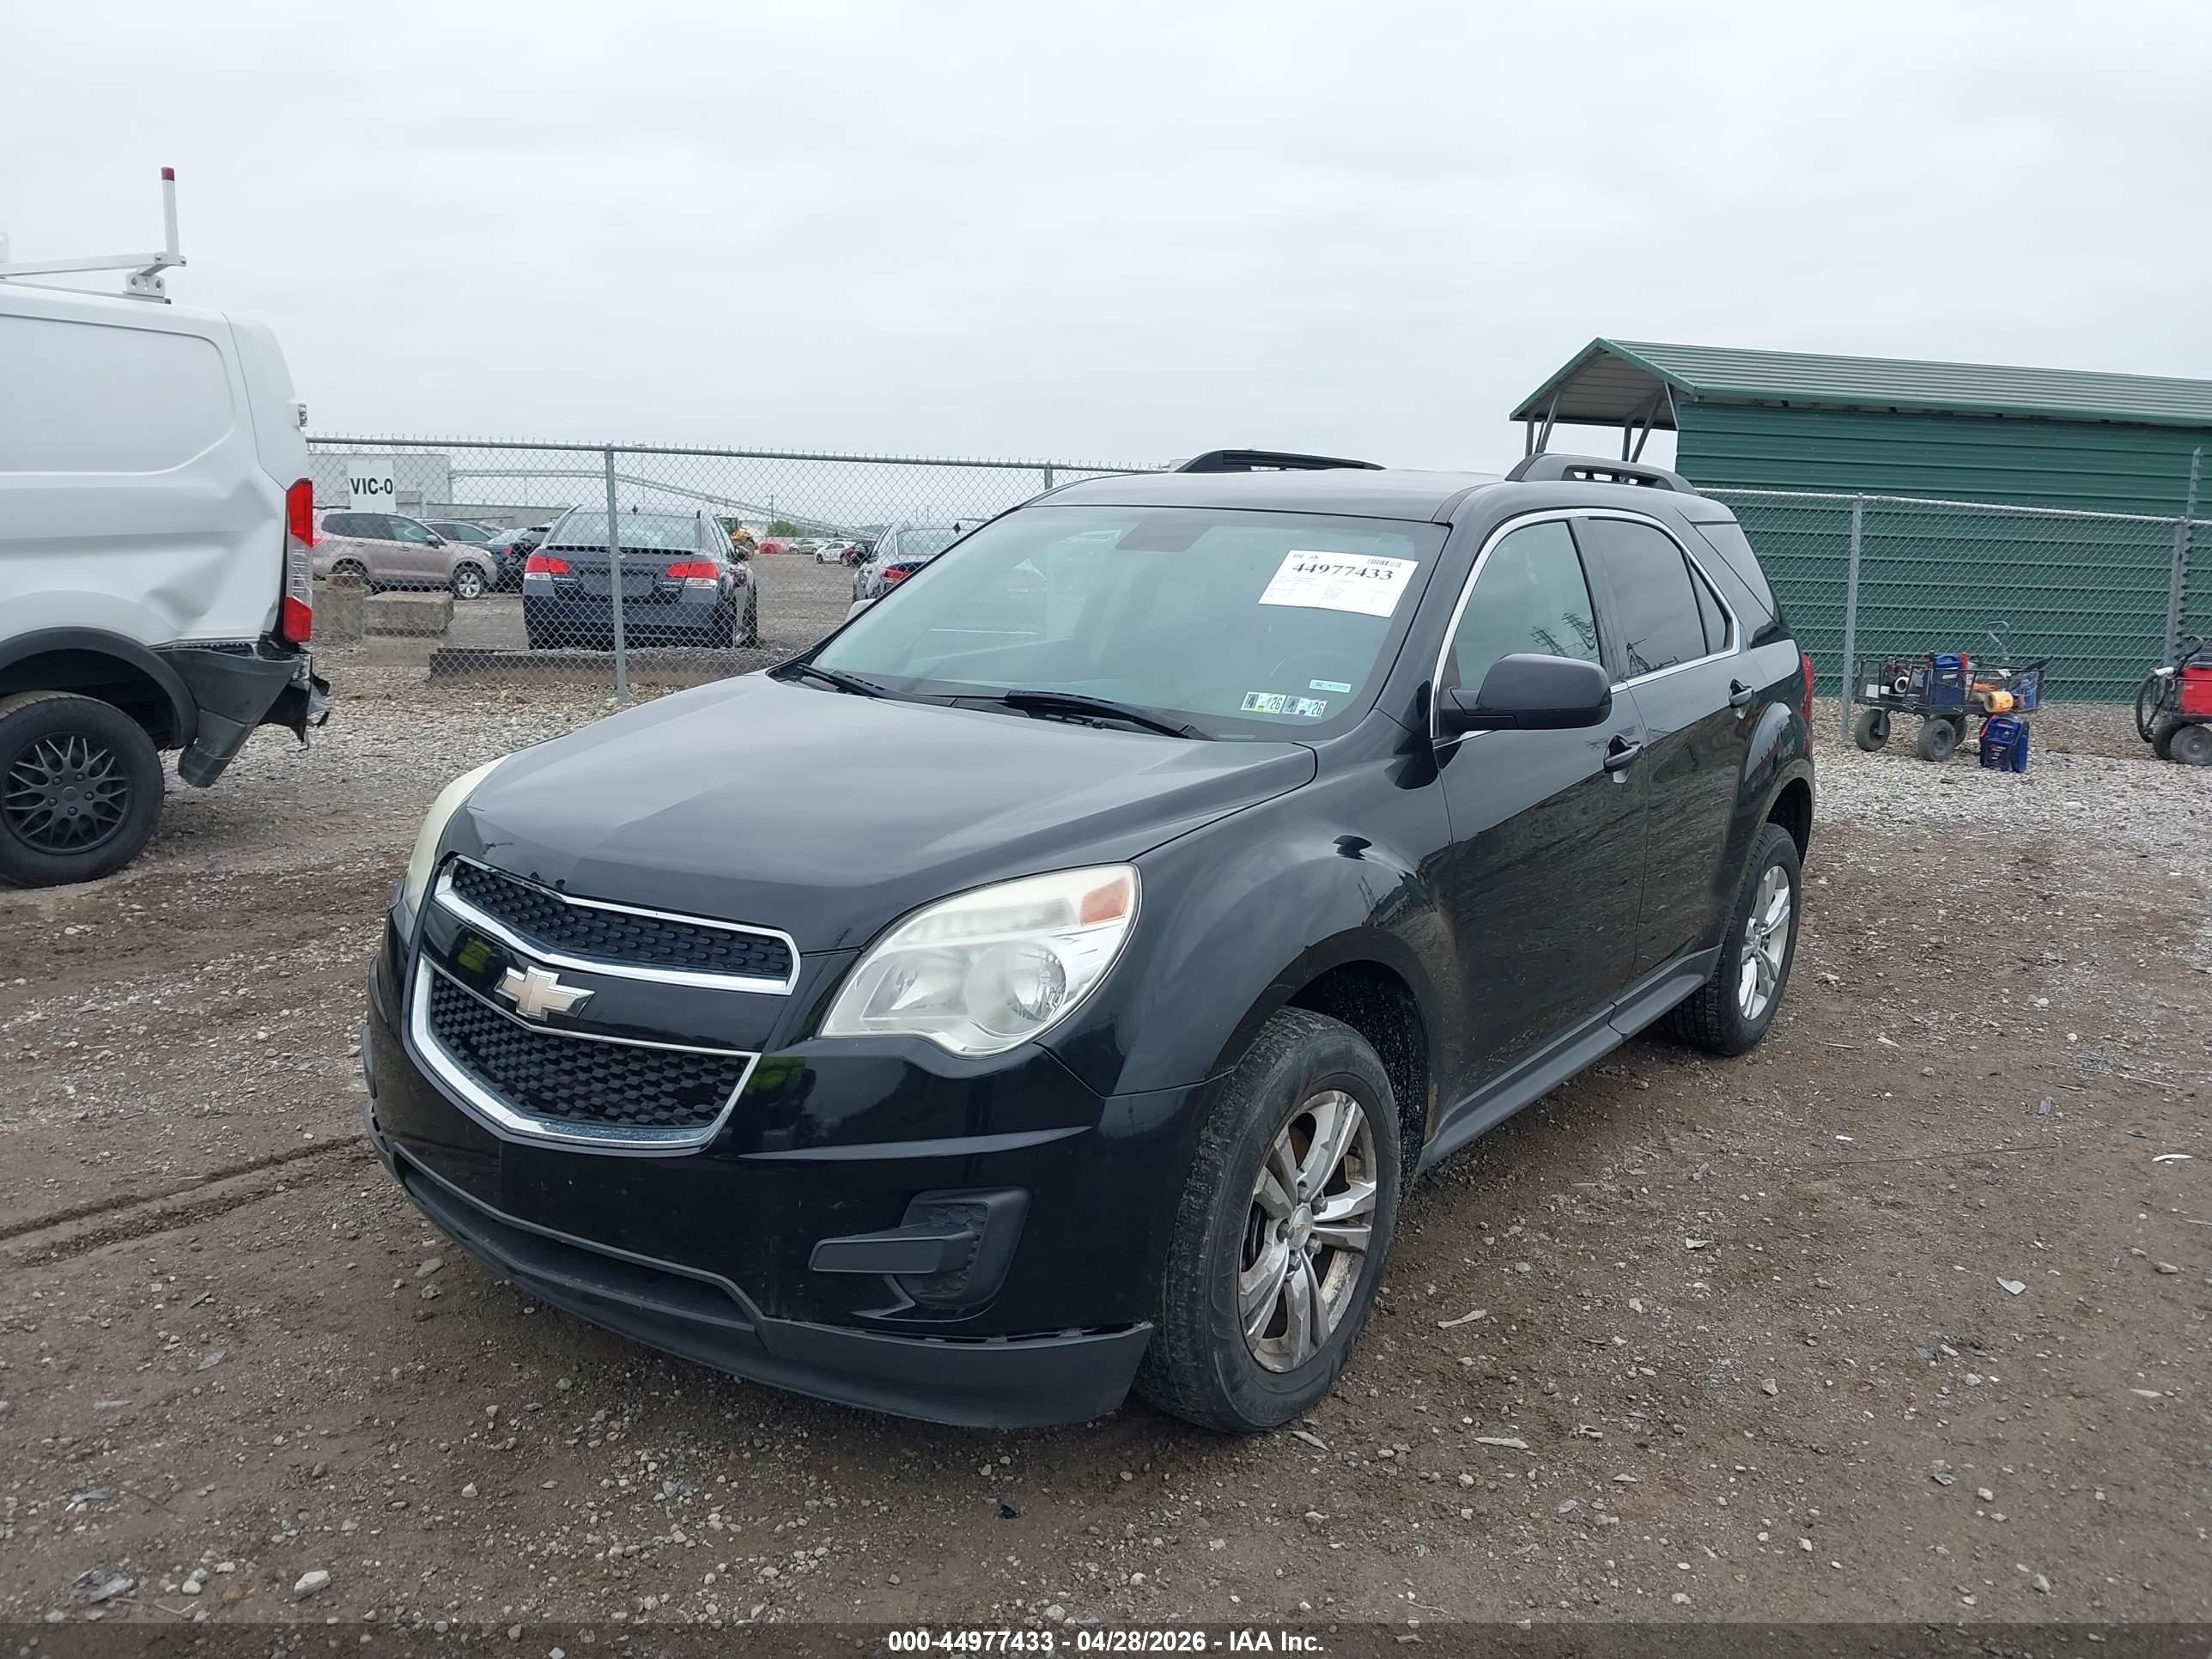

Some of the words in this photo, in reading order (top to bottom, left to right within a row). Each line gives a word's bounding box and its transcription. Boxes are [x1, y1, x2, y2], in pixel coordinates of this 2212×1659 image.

[349, 477, 393, 495] VIC-0
[1291, 562, 1394, 580] 44977433
[1270, 696, 1283, 710] 26
[1311, 702, 1324, 715] 26
